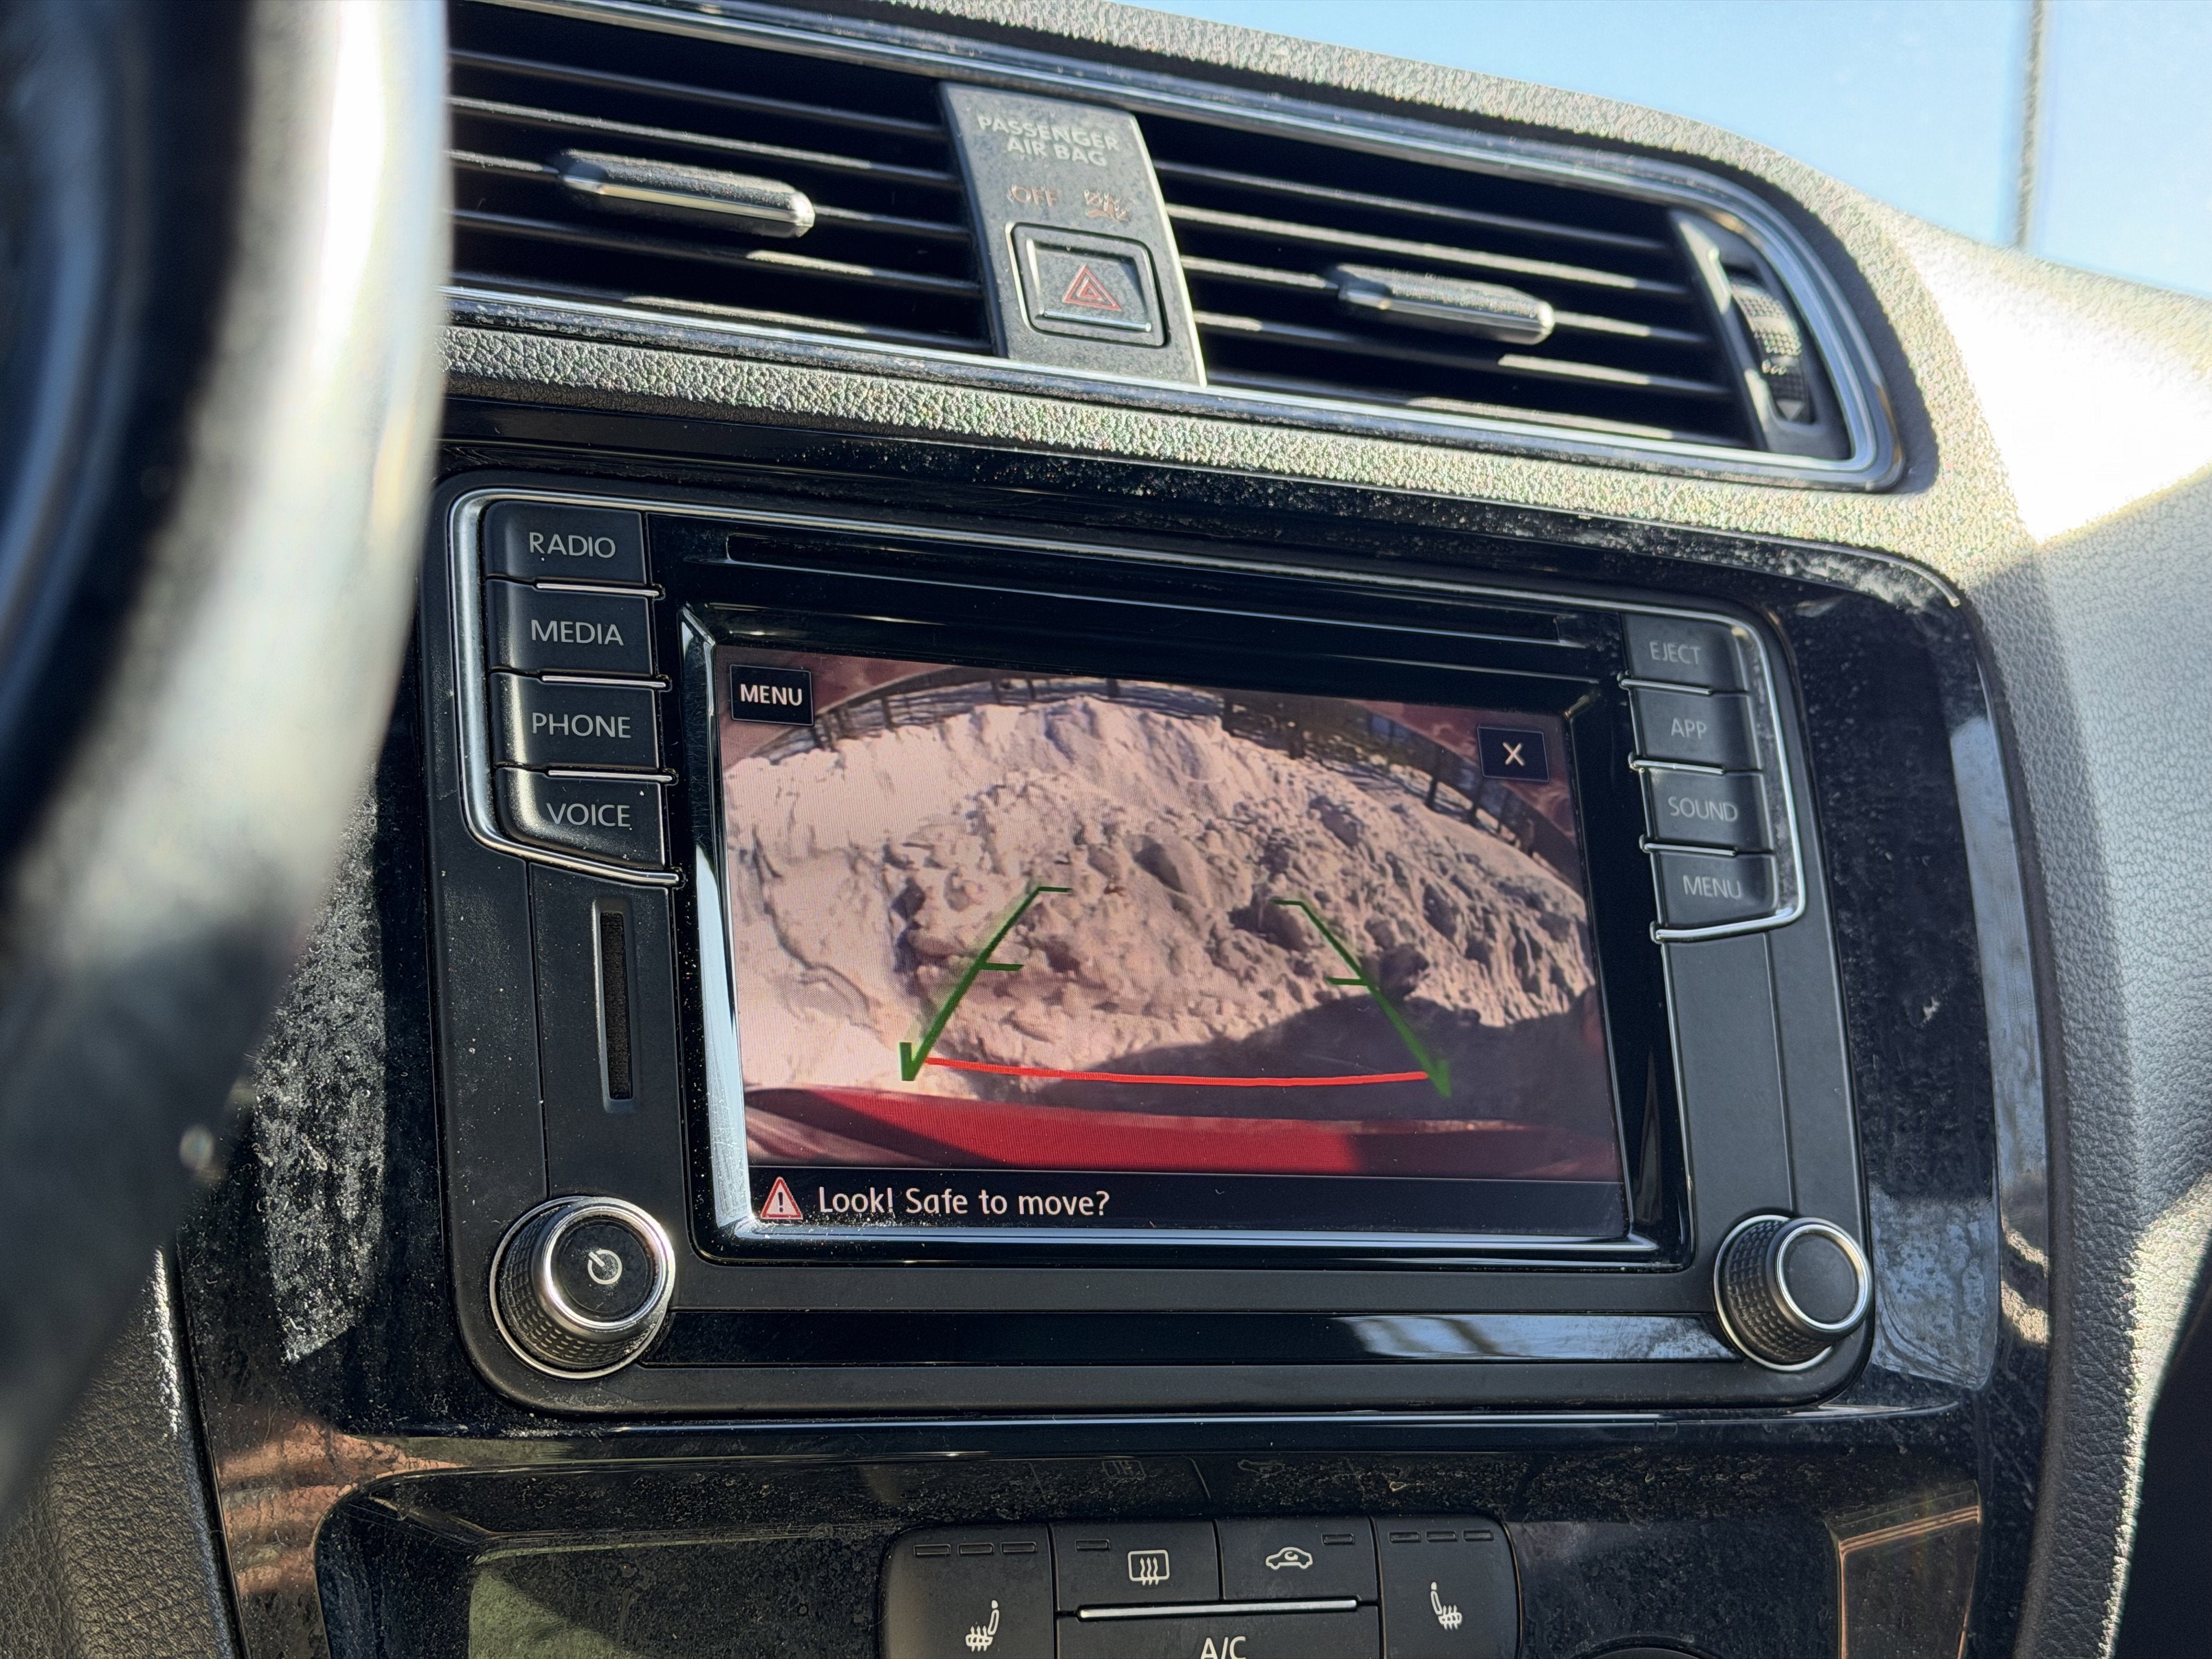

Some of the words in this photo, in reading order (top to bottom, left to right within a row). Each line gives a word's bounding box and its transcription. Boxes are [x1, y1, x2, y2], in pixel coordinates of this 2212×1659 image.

[977, 116, 1120, 151] PASSENGER
[1007, 137, 1047, 157] AIR
[1053, 143, 1107, 166] BAG
[529, 532, 616, 558] RADIO
[531, 619, 624, 646] MEDIA
[1649, 641, 1701, 665] EJECT
[741, 684, 803, 706] MENU
[532, 713, 631, 738] PHONE
[1671, 718, 1707, 739] APP
[546, 803, 631, 827] VOICE
[1668, 797, 1738, 822] SOUND
[1682, 874, 1742, 899] MENU
[819, 1186, 894, 1214] Look!
[906, 1187, 968, 1215] Safe
[979, 1189, 1008, 1216] to
[1018, 1190, 1110, 1217] move?
[1200, 1635, 1246, 1659] A/C
